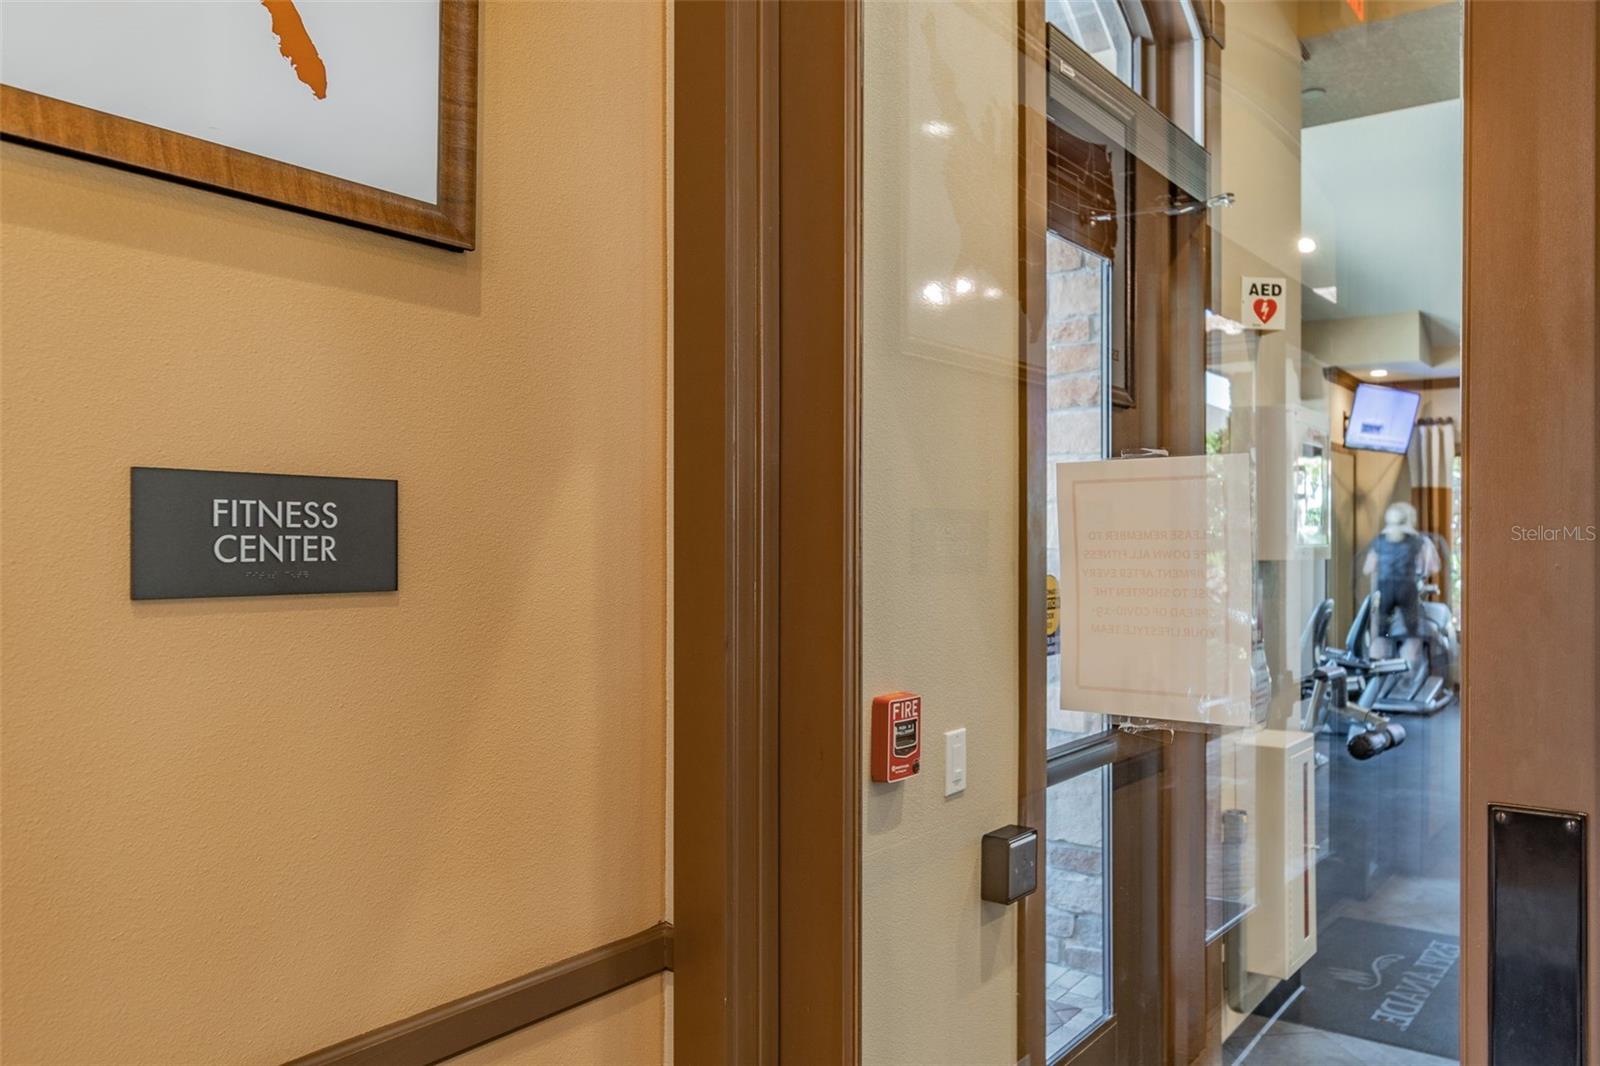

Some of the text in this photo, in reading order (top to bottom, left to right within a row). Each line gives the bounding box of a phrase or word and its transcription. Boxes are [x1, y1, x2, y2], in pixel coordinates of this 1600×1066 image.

[1249, 283, 1283, 297] AED
[213, 499, 338, 529] FITNESS
[213, 534, 337, 563] CENTER
[892, 700, 919, 720] FIRE
